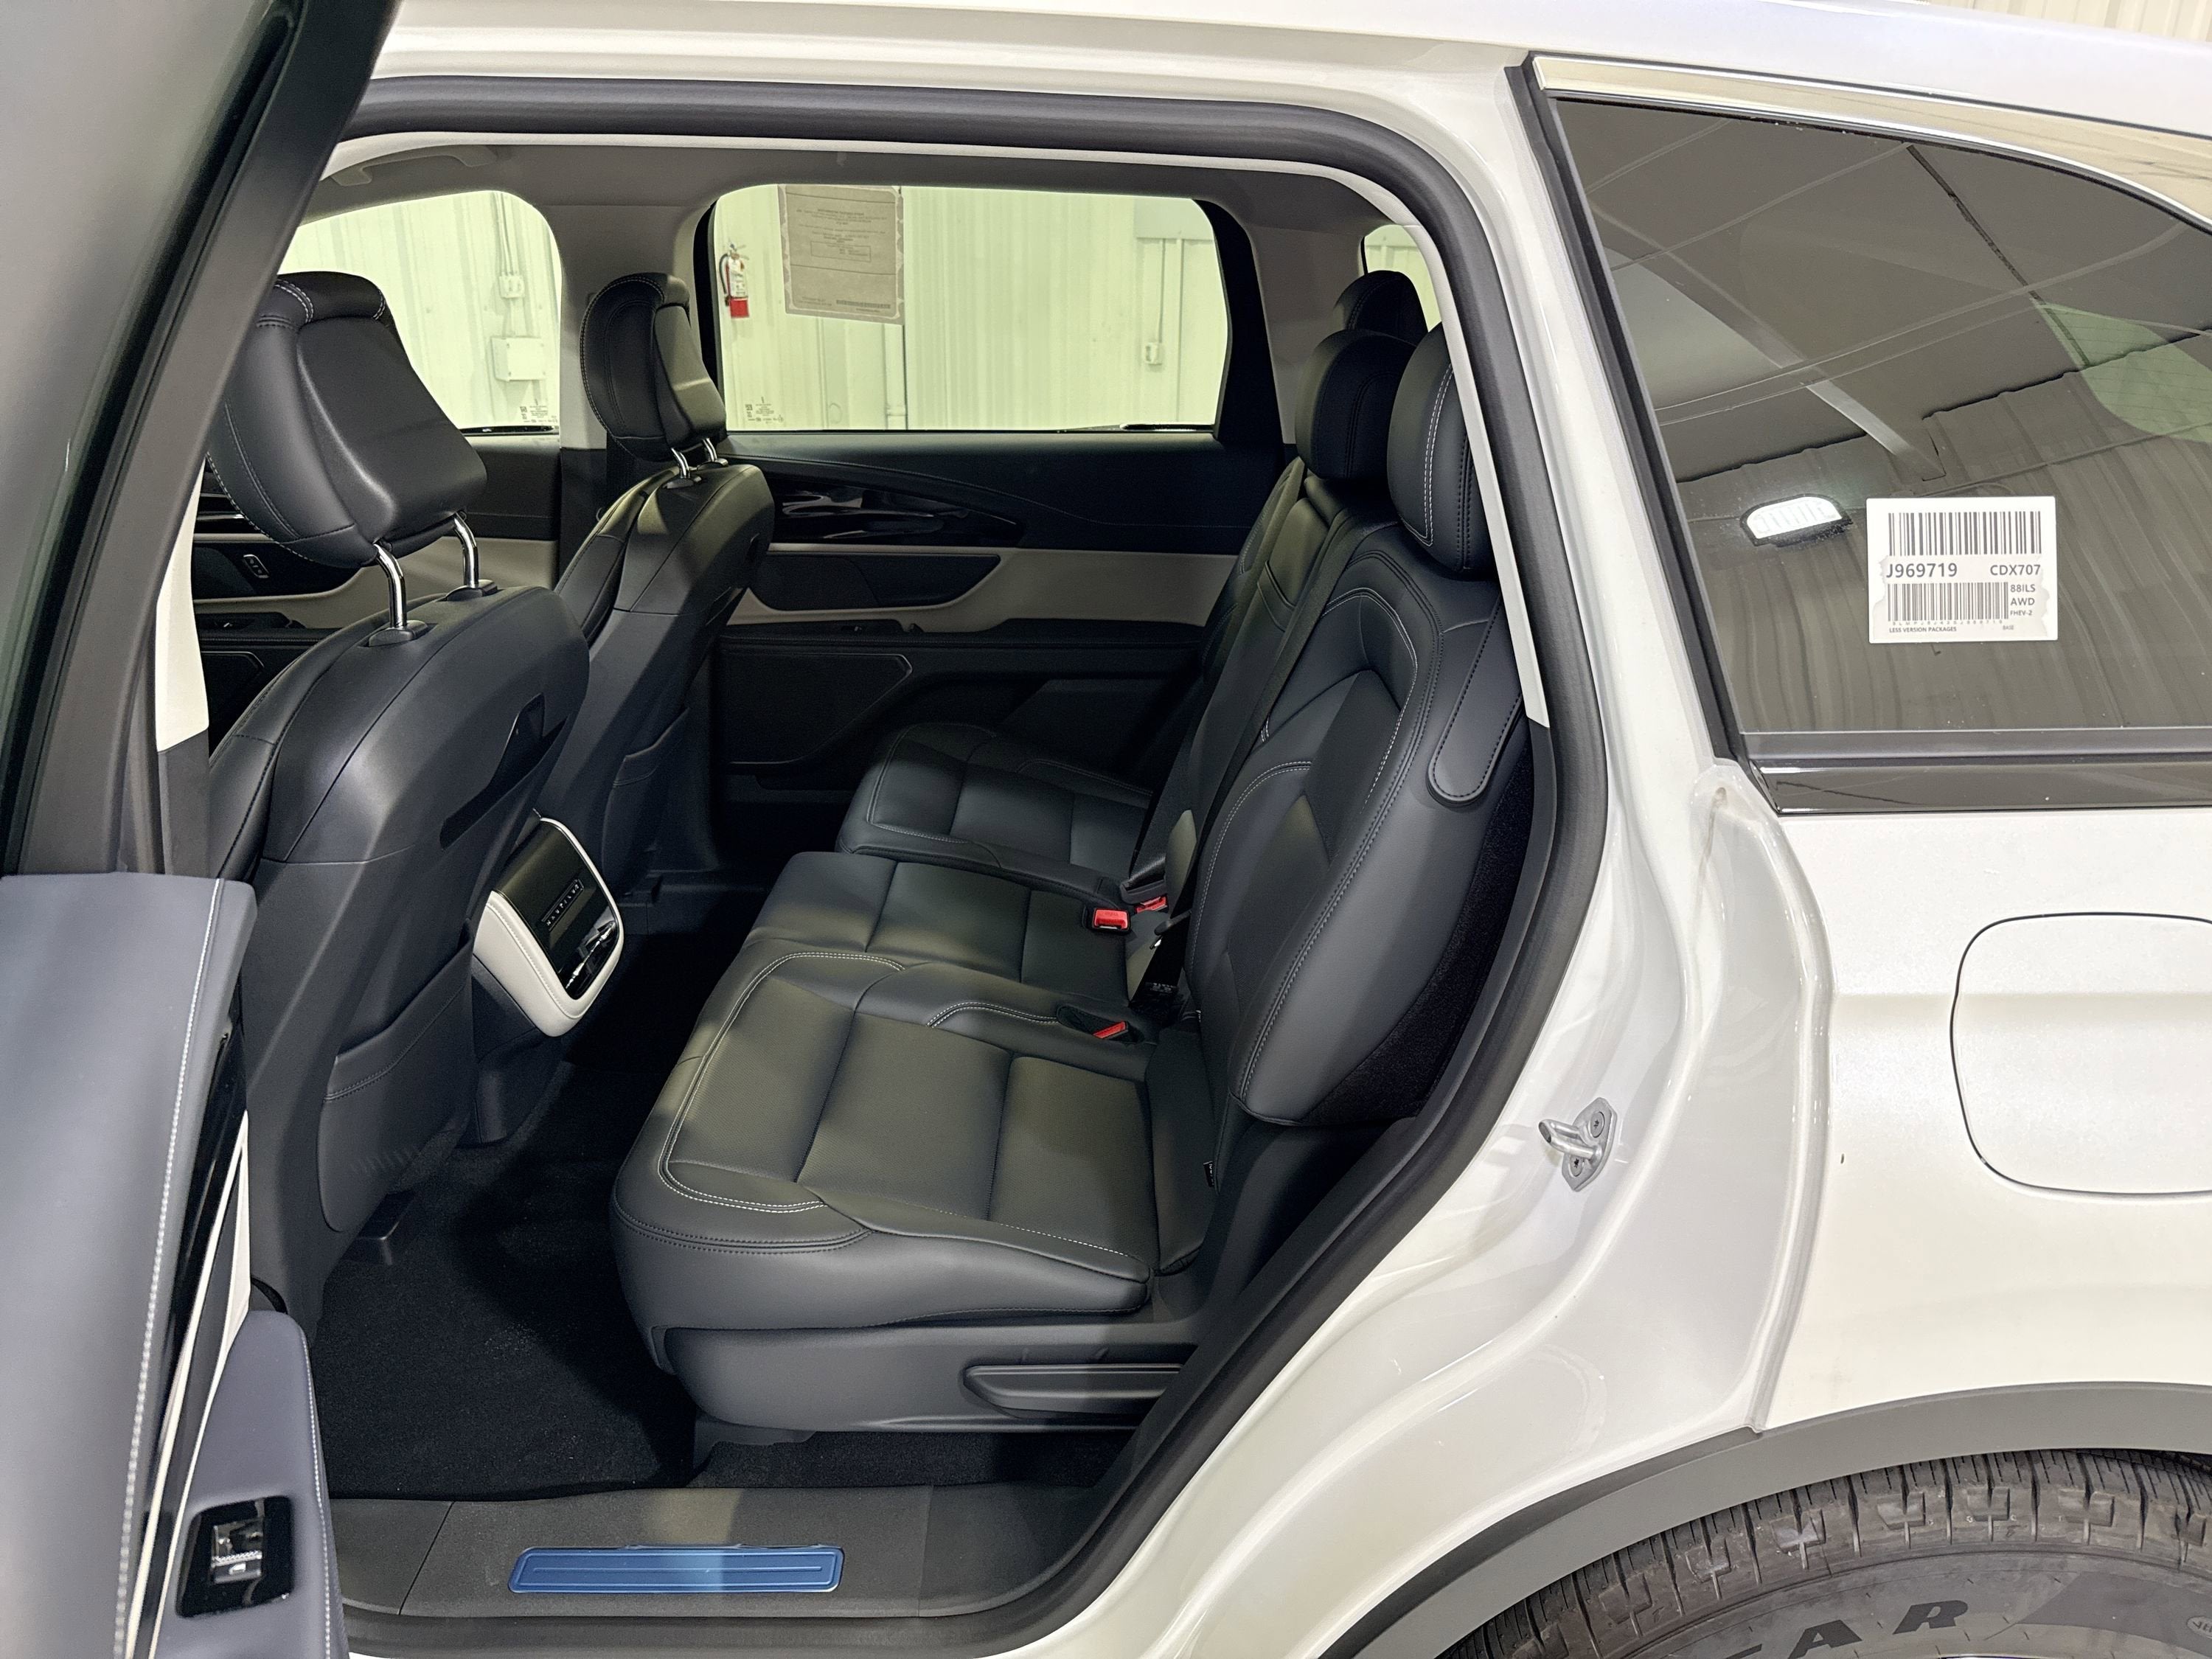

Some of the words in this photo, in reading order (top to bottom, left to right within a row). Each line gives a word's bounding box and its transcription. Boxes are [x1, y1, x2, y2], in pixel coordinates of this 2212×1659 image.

[1886, 563, 1958, 578] J969719
[1990, 564, 2041, 576] CDX707
[2010, 597, 2035, 606] AWD
